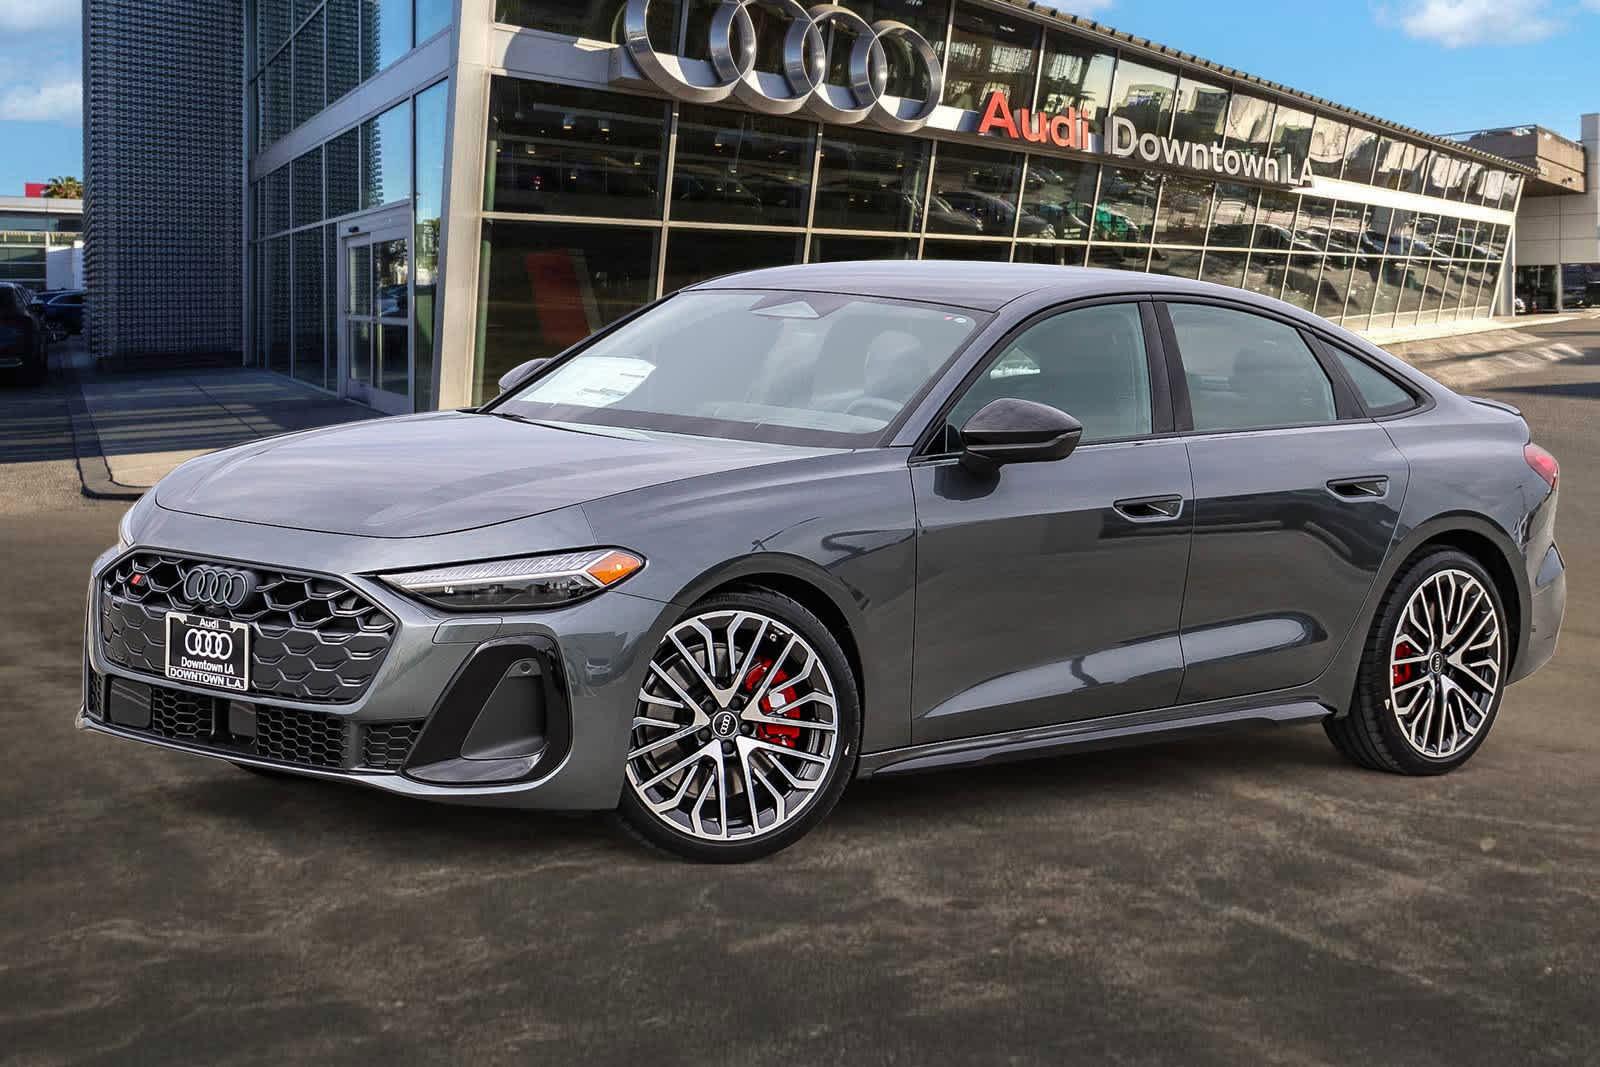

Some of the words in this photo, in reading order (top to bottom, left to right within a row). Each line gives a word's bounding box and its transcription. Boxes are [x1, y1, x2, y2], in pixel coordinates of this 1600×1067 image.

[978, 91, 1089, 150] Audi
[1111, 116, 1280, 182] Downtown
[1286, 153, 1316, 187] LA
[199, 617, 219, 629] Audi
[181, 656, 224, 673] Downtown
[224, 663, 235, 675] LA
[170, 668, 225, 686] DOWNTOWN
